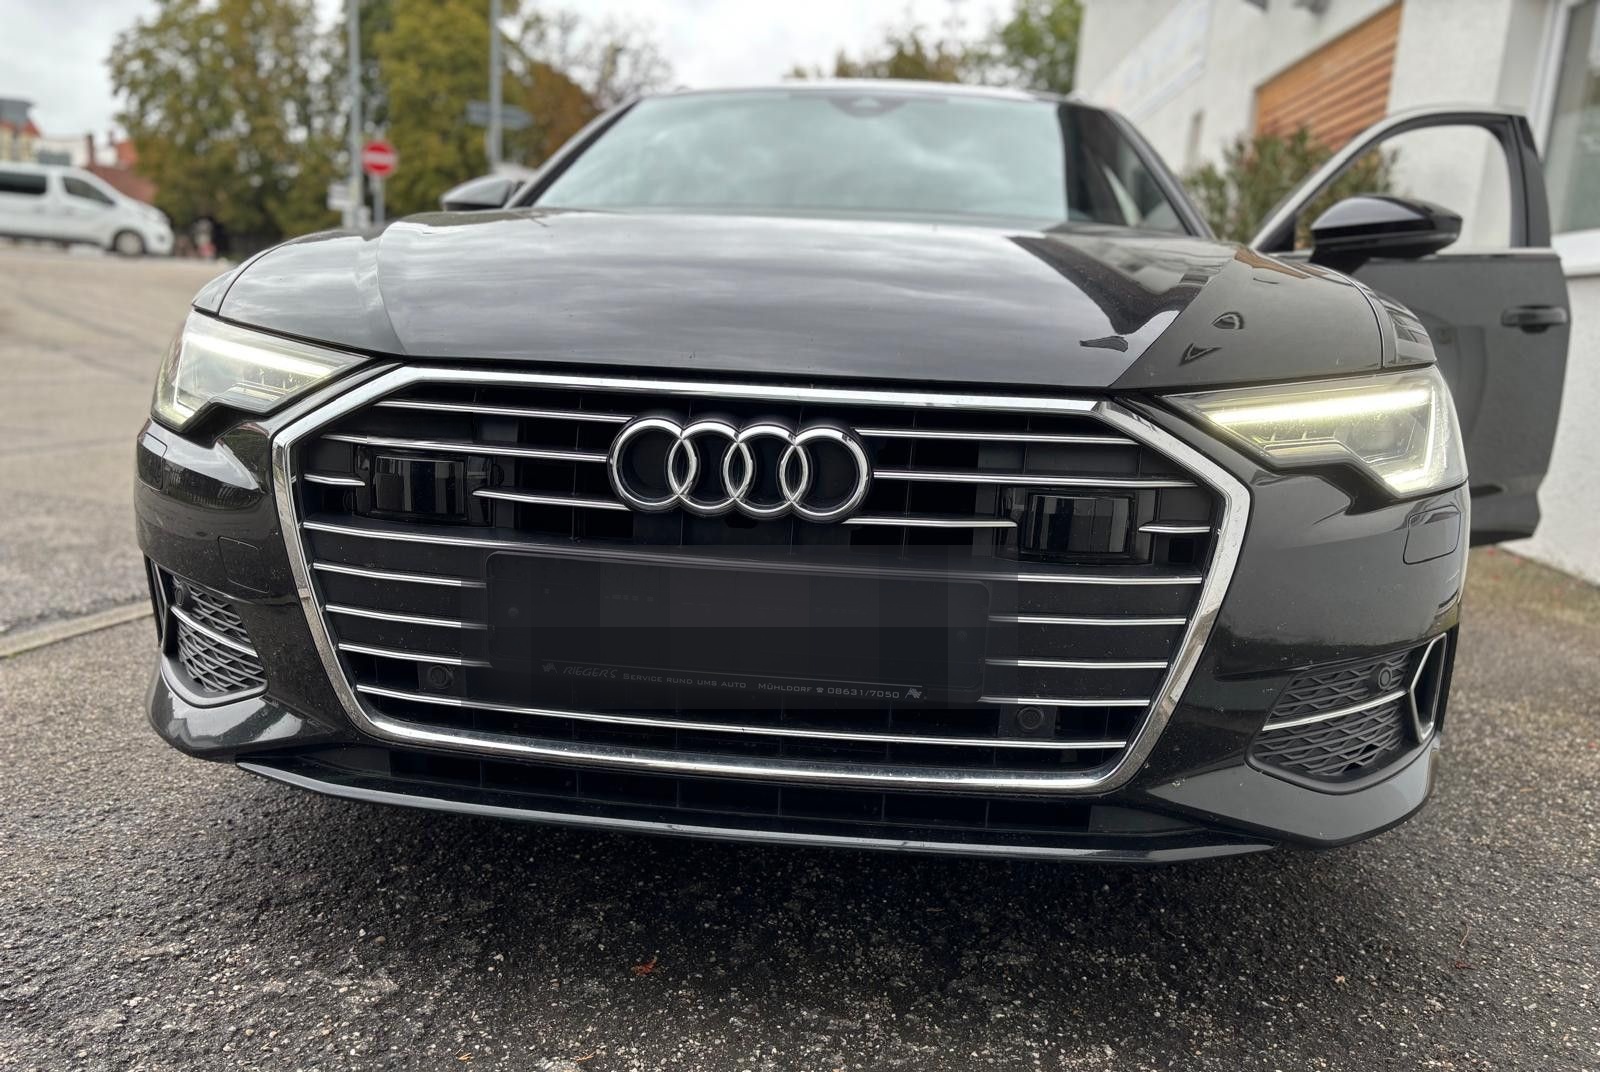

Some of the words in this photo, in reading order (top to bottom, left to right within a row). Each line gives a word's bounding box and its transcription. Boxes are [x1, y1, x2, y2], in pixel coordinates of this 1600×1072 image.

[623, 673, 663, 683] SERVICE
[666, 677, 693, 685] RUND
[697, 679, 718, 687] UMS
[758, 682, 812, 693] MÜHLDORF
[828, 687, 899, 699] 08631/7050
